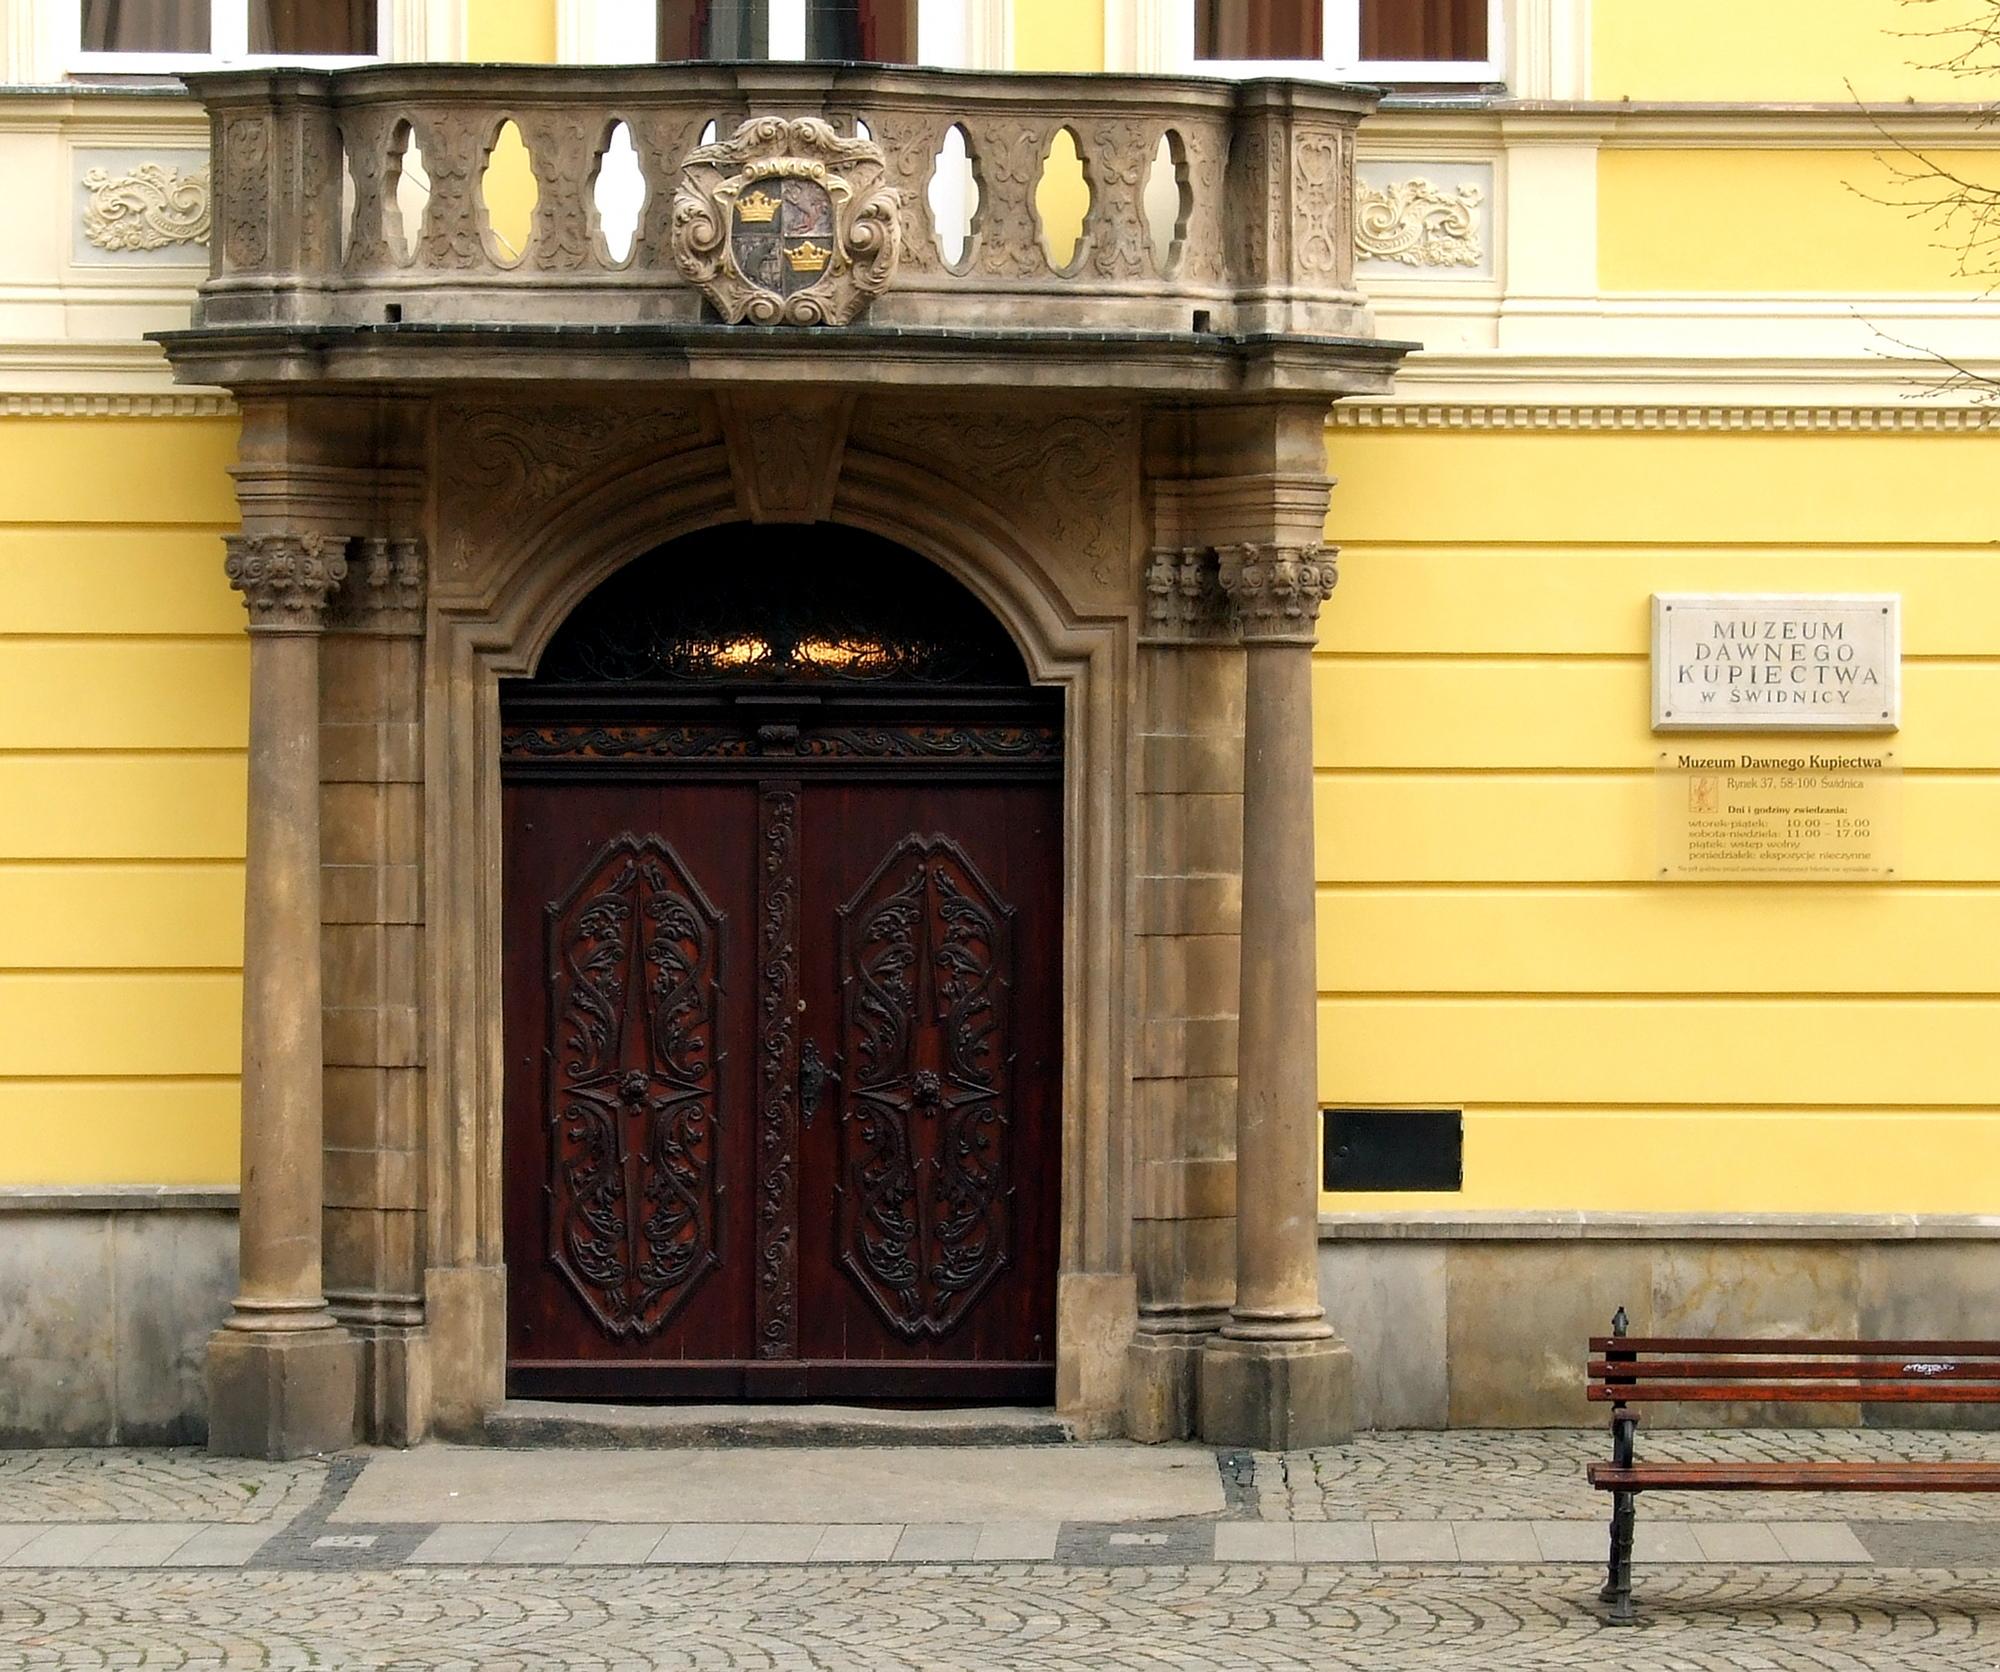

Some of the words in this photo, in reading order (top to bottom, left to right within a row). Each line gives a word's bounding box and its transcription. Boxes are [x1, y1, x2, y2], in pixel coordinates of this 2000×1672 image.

[1713, 621, 1844, 640] MUZEUM
[1695, 642, 1855, 662] DAWNEGO
[1678, 664, 1879, 685] KUPIECTWA
[1729, 686, 1851, 704] ŚWIDNICY
[1678, 755, 1736, 769] Muzeum
[1740, 755, 1806, 772] Dawnego
[1809, 755, 1882, 772] Kupiectwa
[1727, 778, 1758, 790] Rynek
[1780, 778, 1817, 789] 58-100
[1821, 775, 1864, 789] Świdnica
[1727, 806, 1745, 814] Dni
[1747, 806, 1752, 814] i
[1754, 806, 1791, 815] godziny
[1786, 819, 1821, 828] 10.00
[1836, 819, 1870, 828] 15.00
[1786, 829, 1821, 838] 11.00
[1836, 829, 1870, 838] 17.00
[1766, 839, 1801, 849] wolny
[1759, 850, 1816, 861] ekspozycje
[1819, 851, 1871, 861] nieczynne
